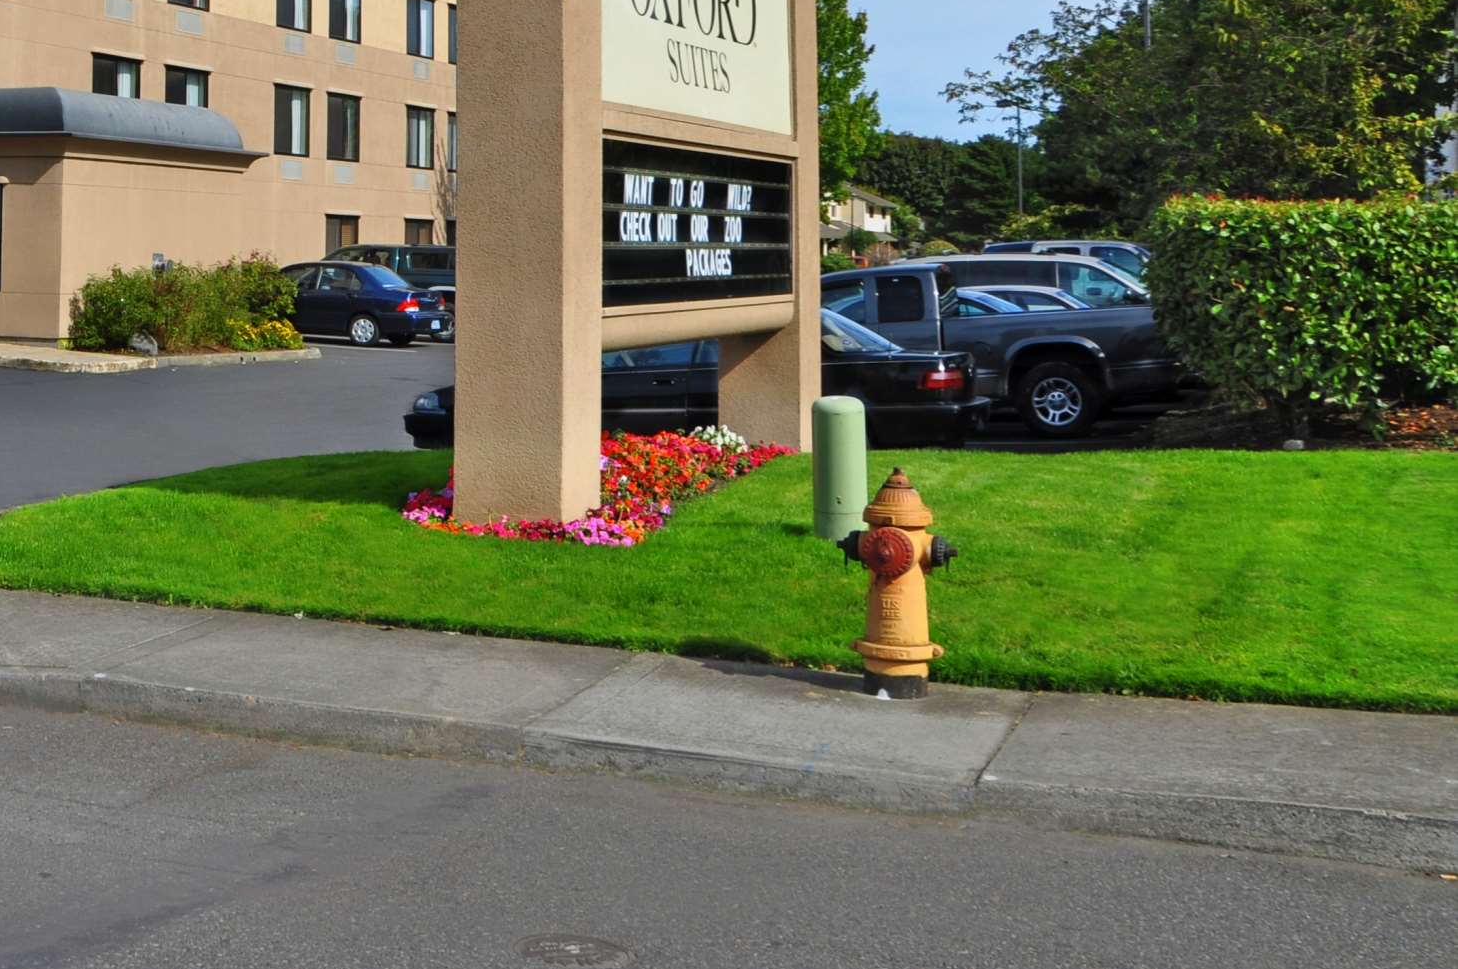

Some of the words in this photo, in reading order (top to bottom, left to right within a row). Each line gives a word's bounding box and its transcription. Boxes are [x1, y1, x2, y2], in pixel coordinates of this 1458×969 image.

[666, 38, 731, 94] SUITES
[624, 174, 654, 206] WANT
[670, 178, 684, 208] TO
[690, 180, 705, 209] GO
[727, 184, 752, 211] WILD?
[620, 211, 652, 242] CHECK
[657, 213, 678, 242] OUT
[691, 215, 709, 242] OUR
[724, 216, 742, 243] ZOO
[686, 249, 732, 277] PACKAGES
